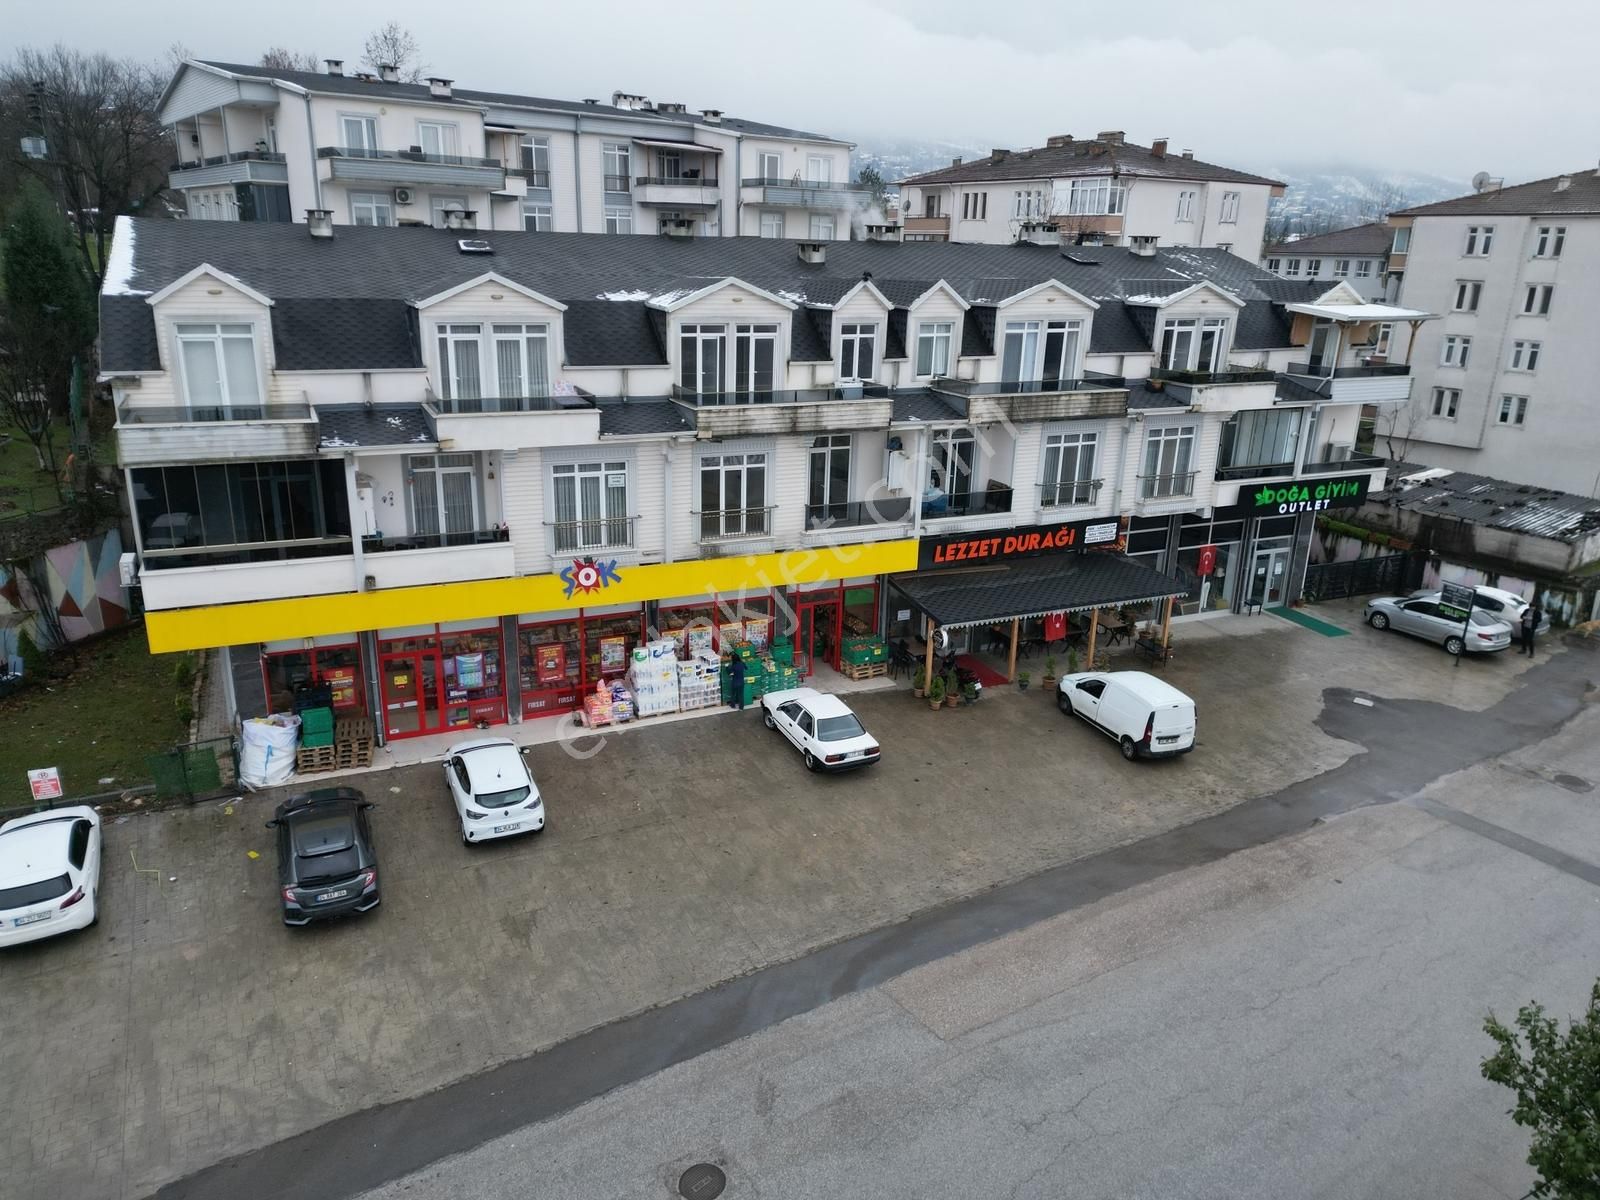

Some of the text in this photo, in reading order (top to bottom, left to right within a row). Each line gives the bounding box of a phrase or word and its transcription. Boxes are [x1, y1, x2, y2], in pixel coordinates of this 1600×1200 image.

[1264, 480, 1360, 505] DOĞA GİYİM
[1278, 499, 1331, 515] OUTLET
[933, 526, 1076, 564] LEZZET DURAĞI
[559, 558, 622, 600] ŞOK
